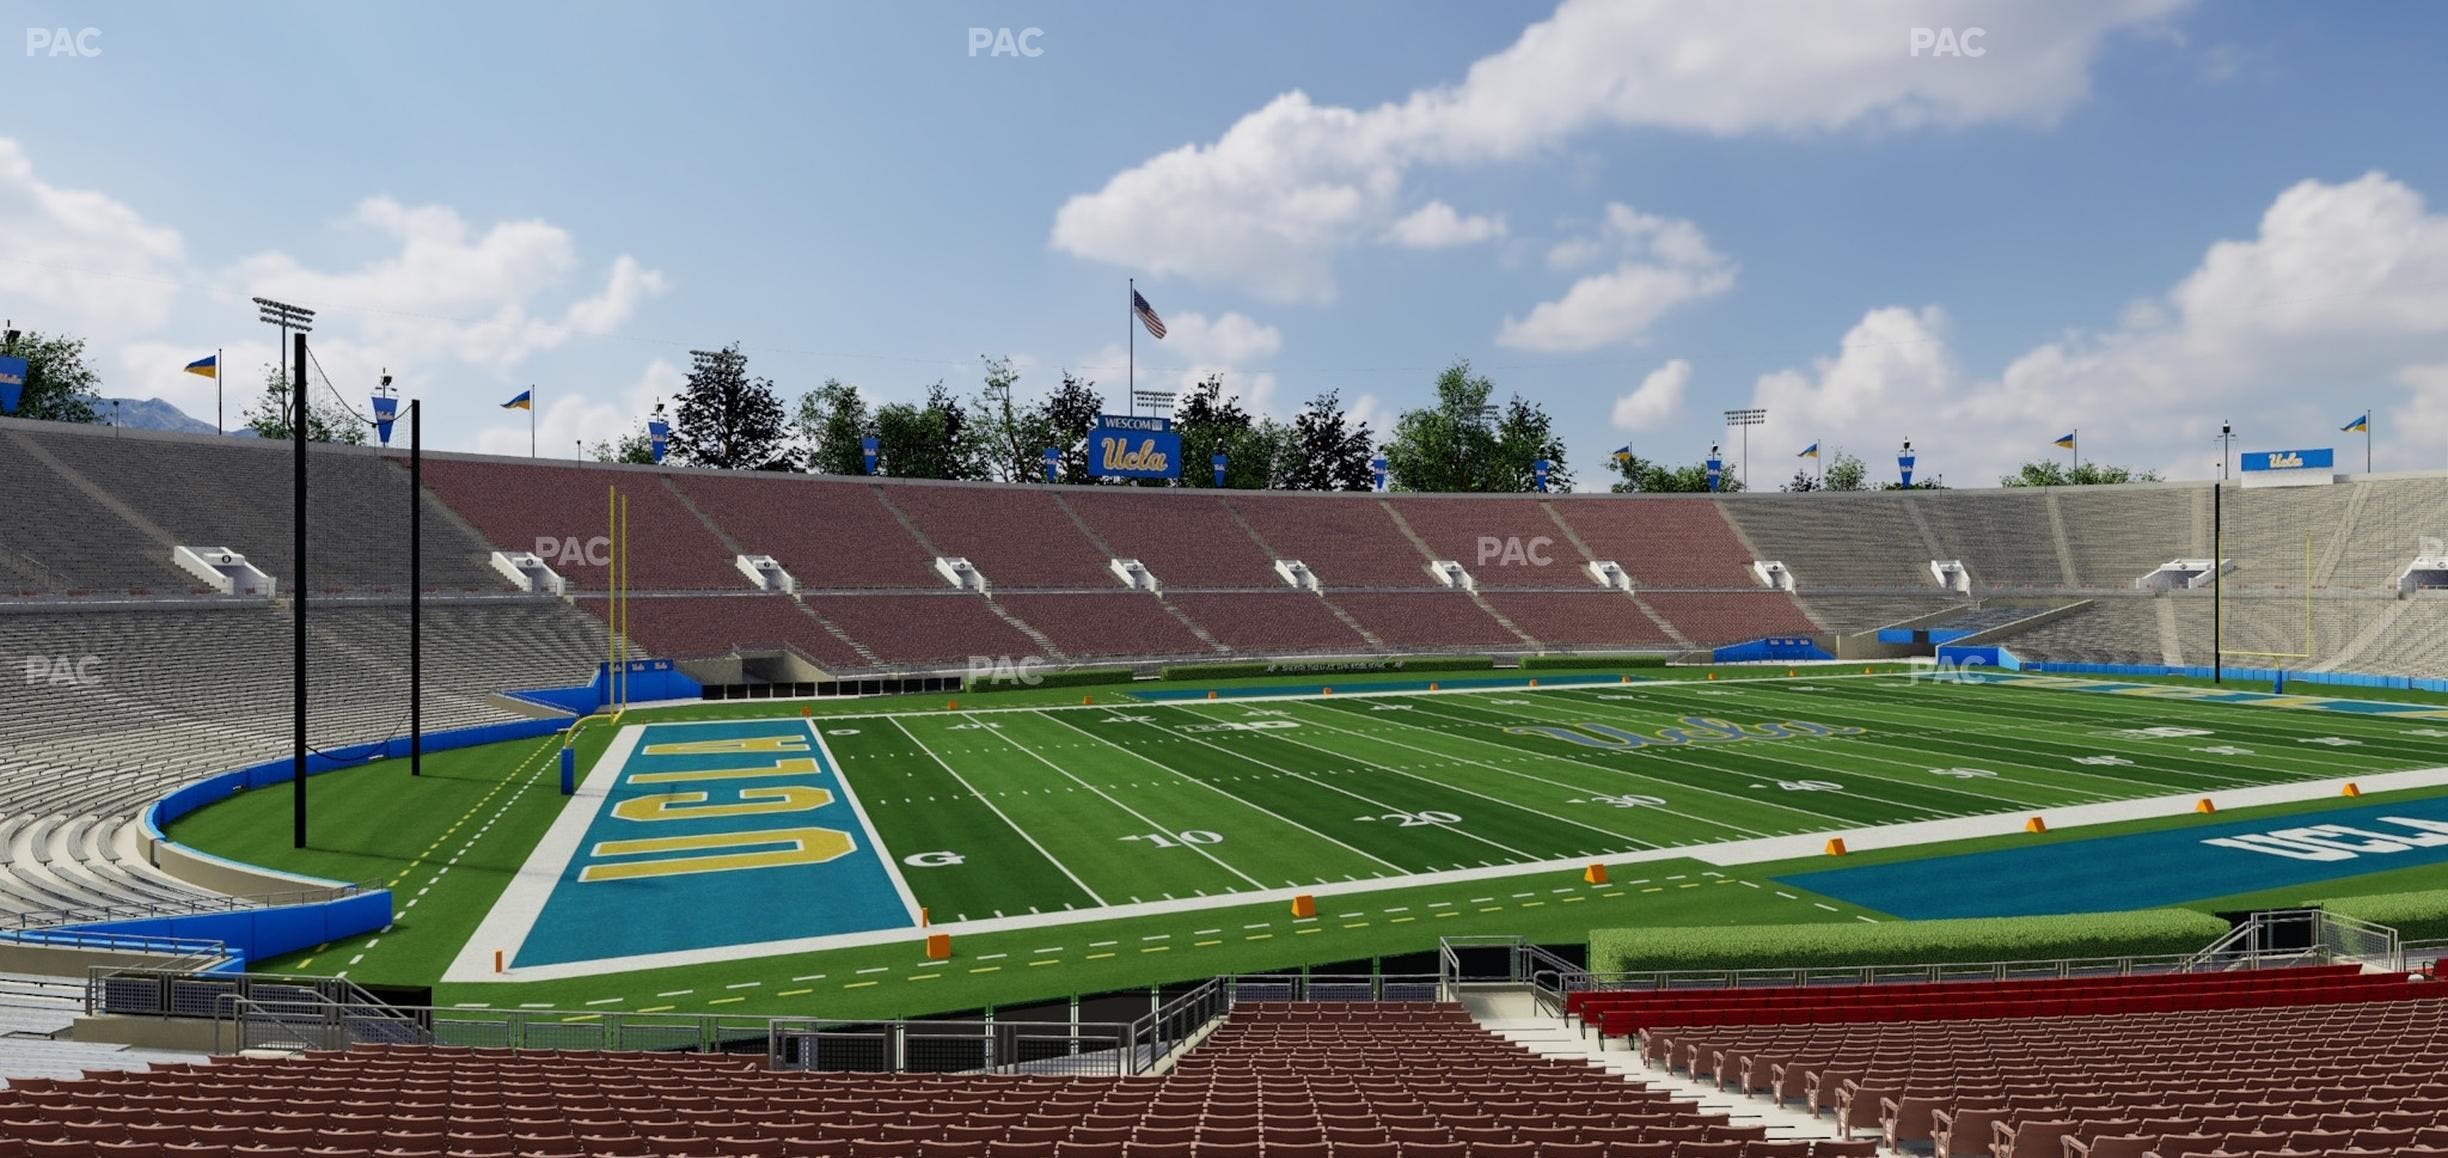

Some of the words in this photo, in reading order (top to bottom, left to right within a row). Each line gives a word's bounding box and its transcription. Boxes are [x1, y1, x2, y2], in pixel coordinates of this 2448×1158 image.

[1104, 417, 1152, 431] WESCOM
[1101, 436, 1169, 472] Ucla
[1776, 779, 1844, 792] 40
[577, 734, 857, 882] UCLA
[1591, 794, 1667, 808] 30
[1381, 810, 1463, 827] 20
[1140, 830, 1224, 849] 10
[903, 850, 965, 868] G
